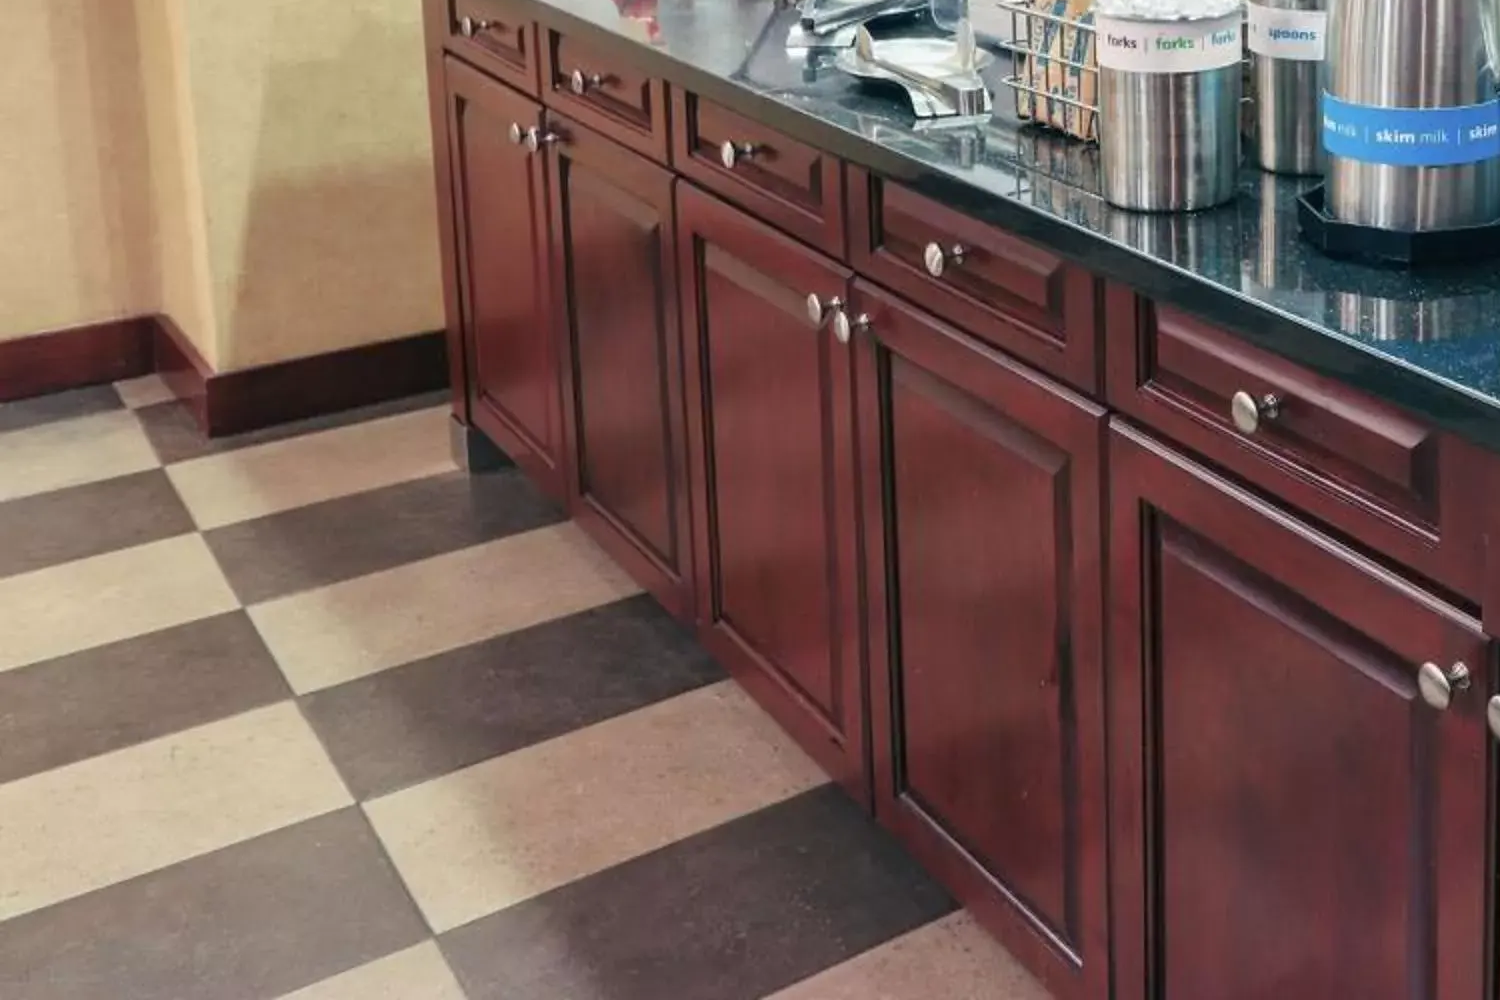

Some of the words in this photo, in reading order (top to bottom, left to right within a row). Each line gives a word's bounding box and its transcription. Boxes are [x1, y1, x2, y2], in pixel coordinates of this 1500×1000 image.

[1106, 33, 1138, 50] forks
[1155, 37, 1195, 51] forks
[1375, 127, 1416, 144] skim
[1419, 129, 1450, 145] milk
[1469, 122, 1498, 140] skim
